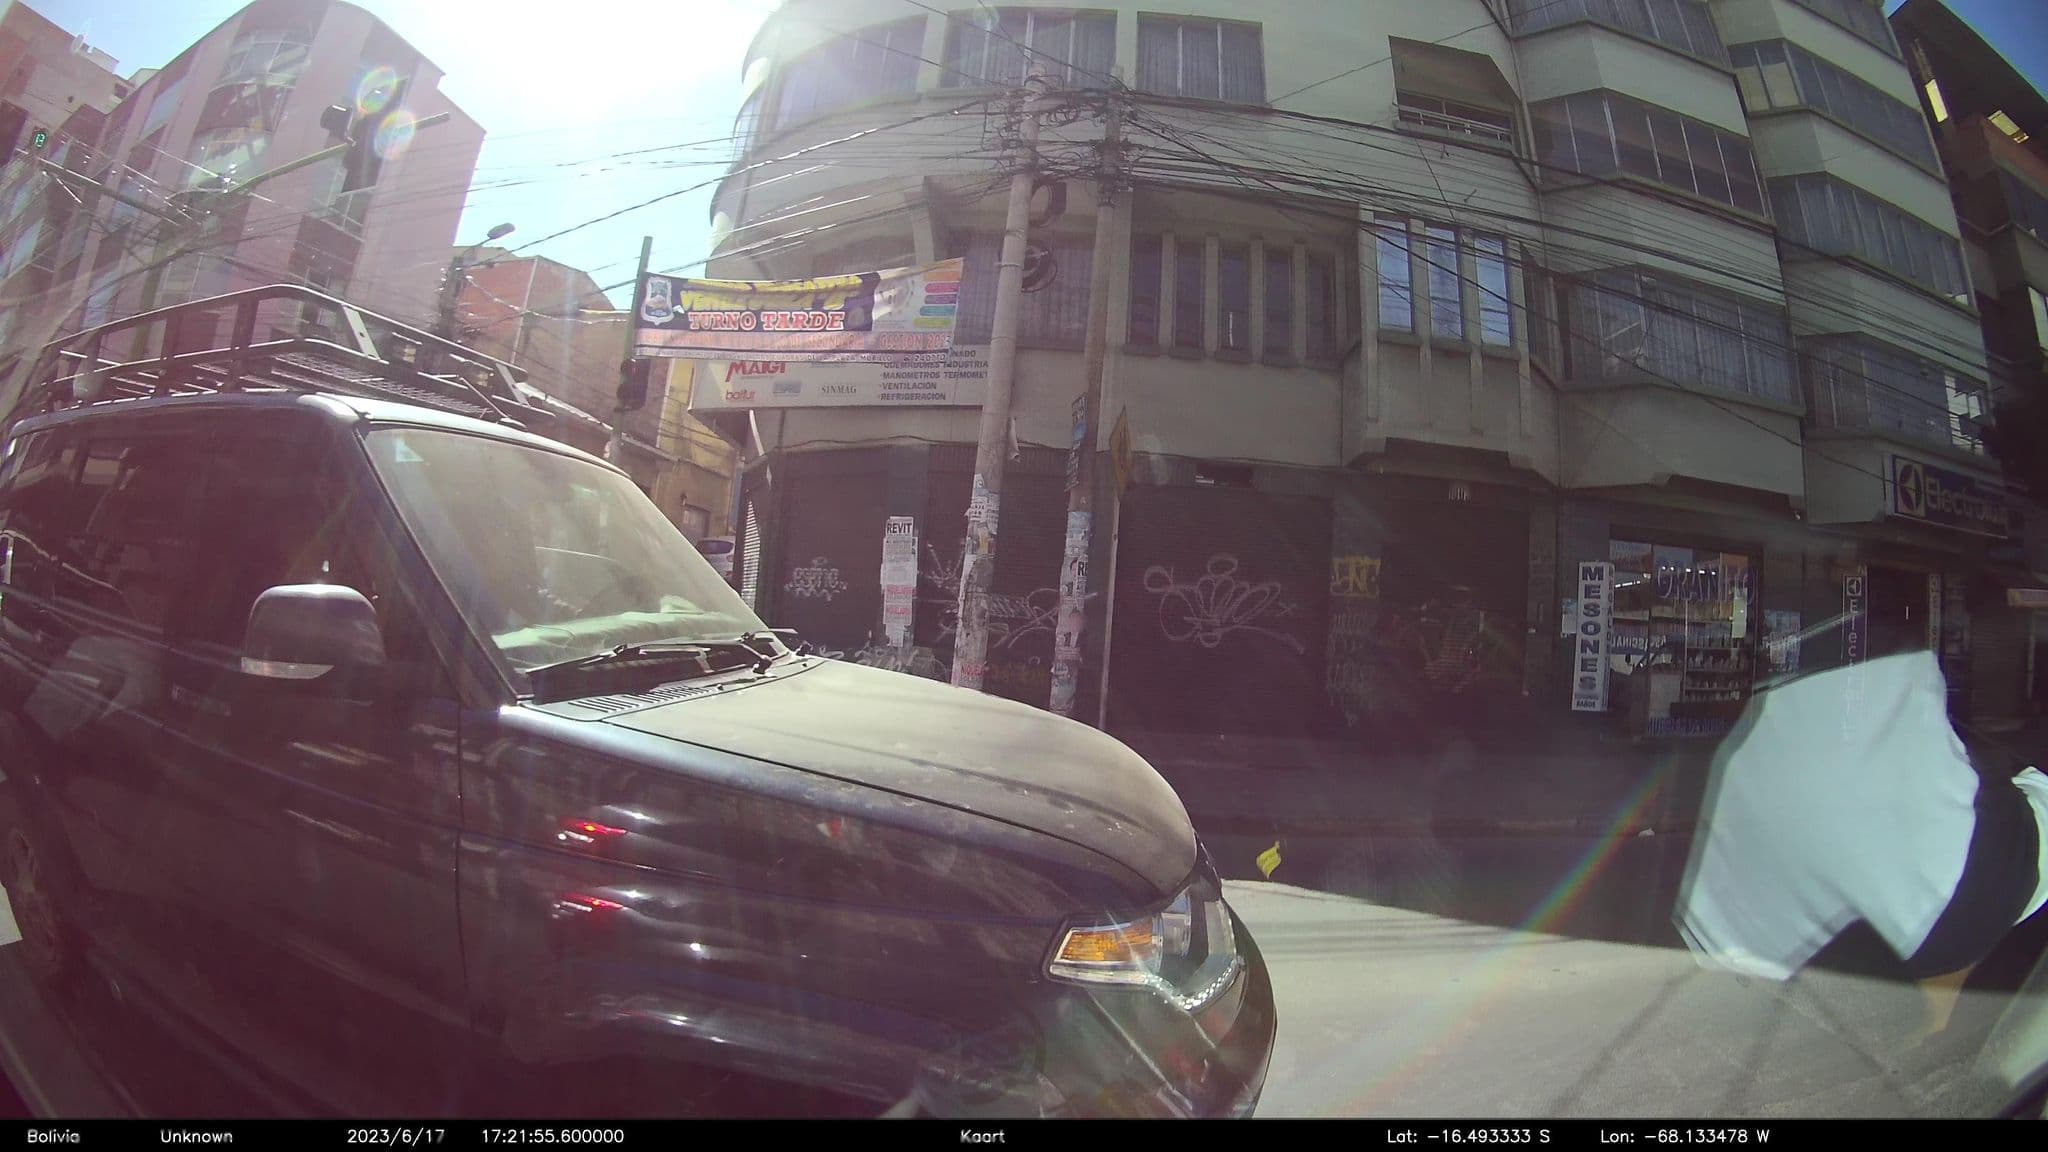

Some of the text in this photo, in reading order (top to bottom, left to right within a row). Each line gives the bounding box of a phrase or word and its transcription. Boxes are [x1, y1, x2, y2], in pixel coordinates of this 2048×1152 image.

[688, 311, 845, 332] TURNO TARDE
[822, 384, 857, 395] SINMAG
[886, 522, 913, 535] REVIT
[1578, 565, 1605, 691] MESONES
